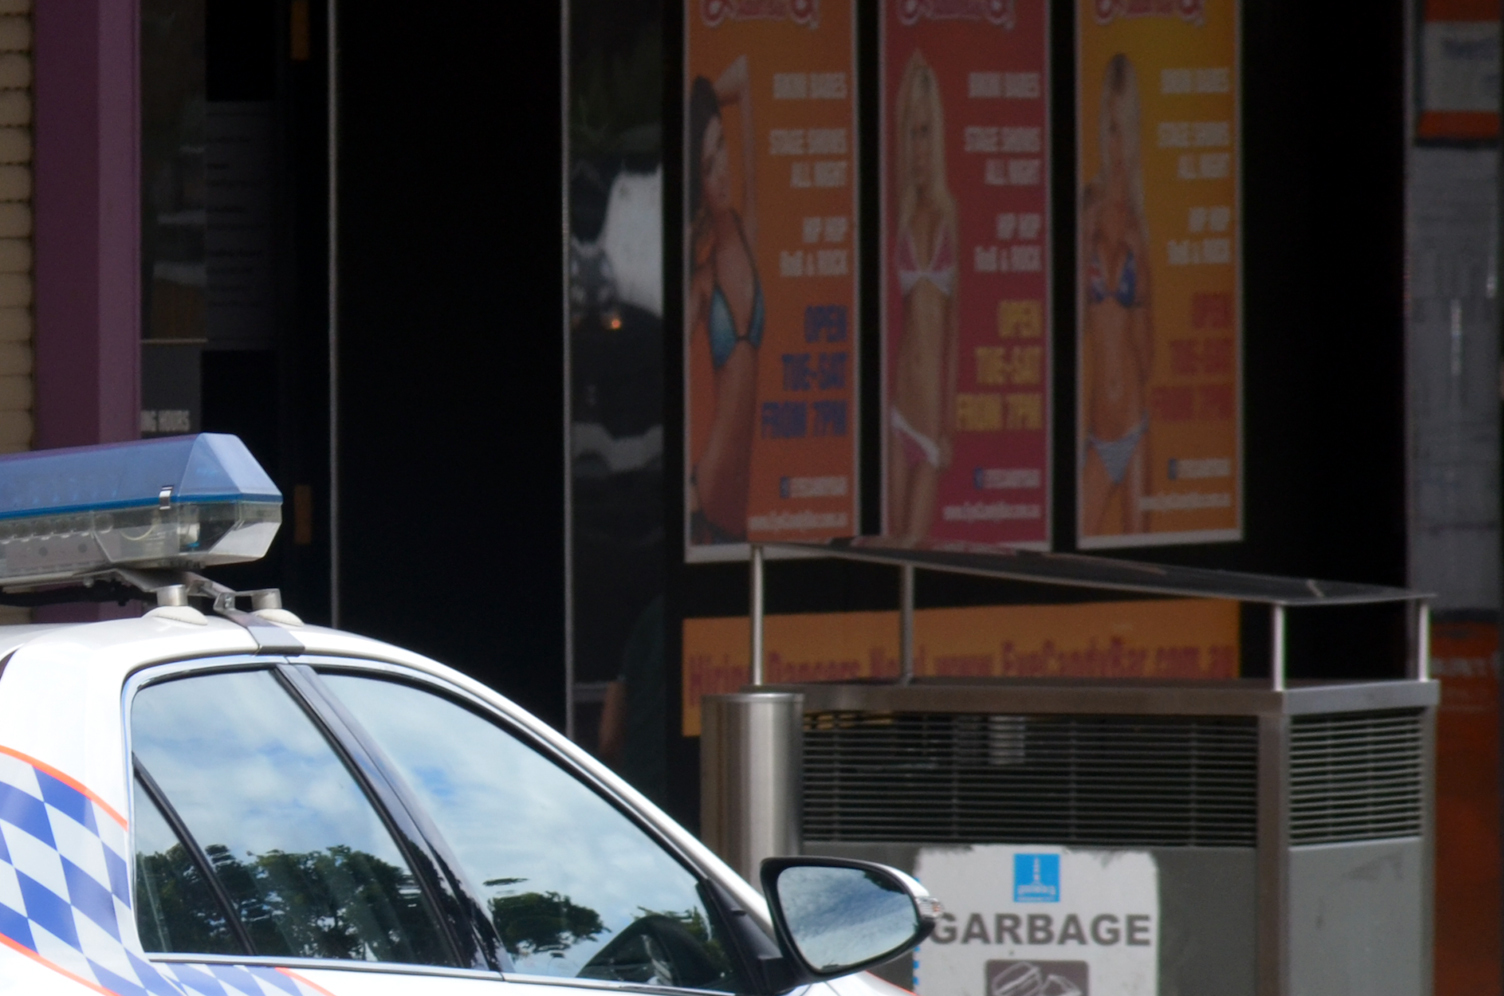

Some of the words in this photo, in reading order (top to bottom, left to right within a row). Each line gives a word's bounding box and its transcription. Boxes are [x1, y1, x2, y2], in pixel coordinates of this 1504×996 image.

[805, 305, 847, 342] OPEN
[998, 300, 1041, 337] OPEN
[762, 401, 806, 437] FROM
[956, 393, 1001, 430] FROM
[930, 913, 1151, 946] GARBAGE
